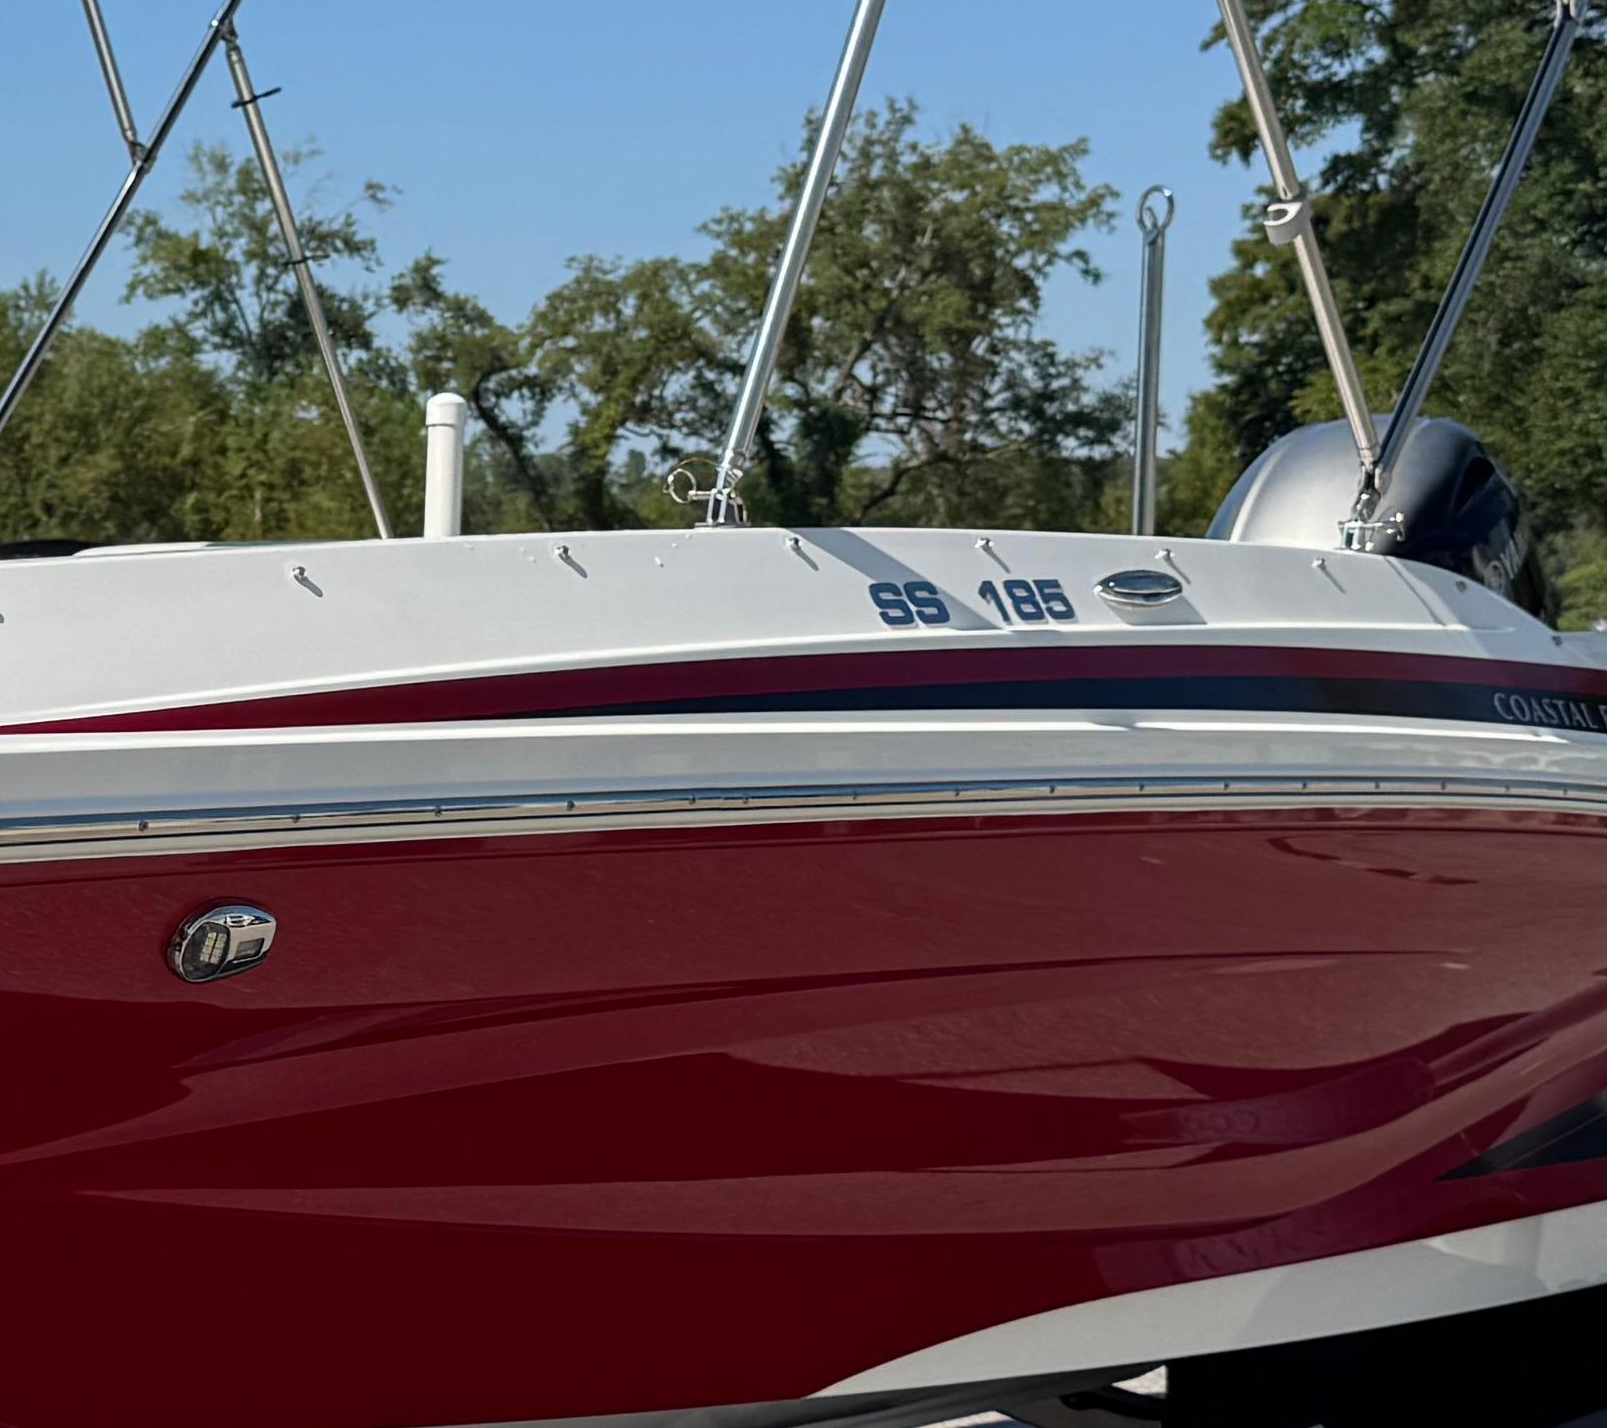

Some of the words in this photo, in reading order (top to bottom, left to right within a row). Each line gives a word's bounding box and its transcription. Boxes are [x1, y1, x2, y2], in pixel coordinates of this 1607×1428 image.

[868, 580, 950, 626] SS
[978, 578, 1076, 624] 185
[1493, 691, 1598, 730] COASTAL
